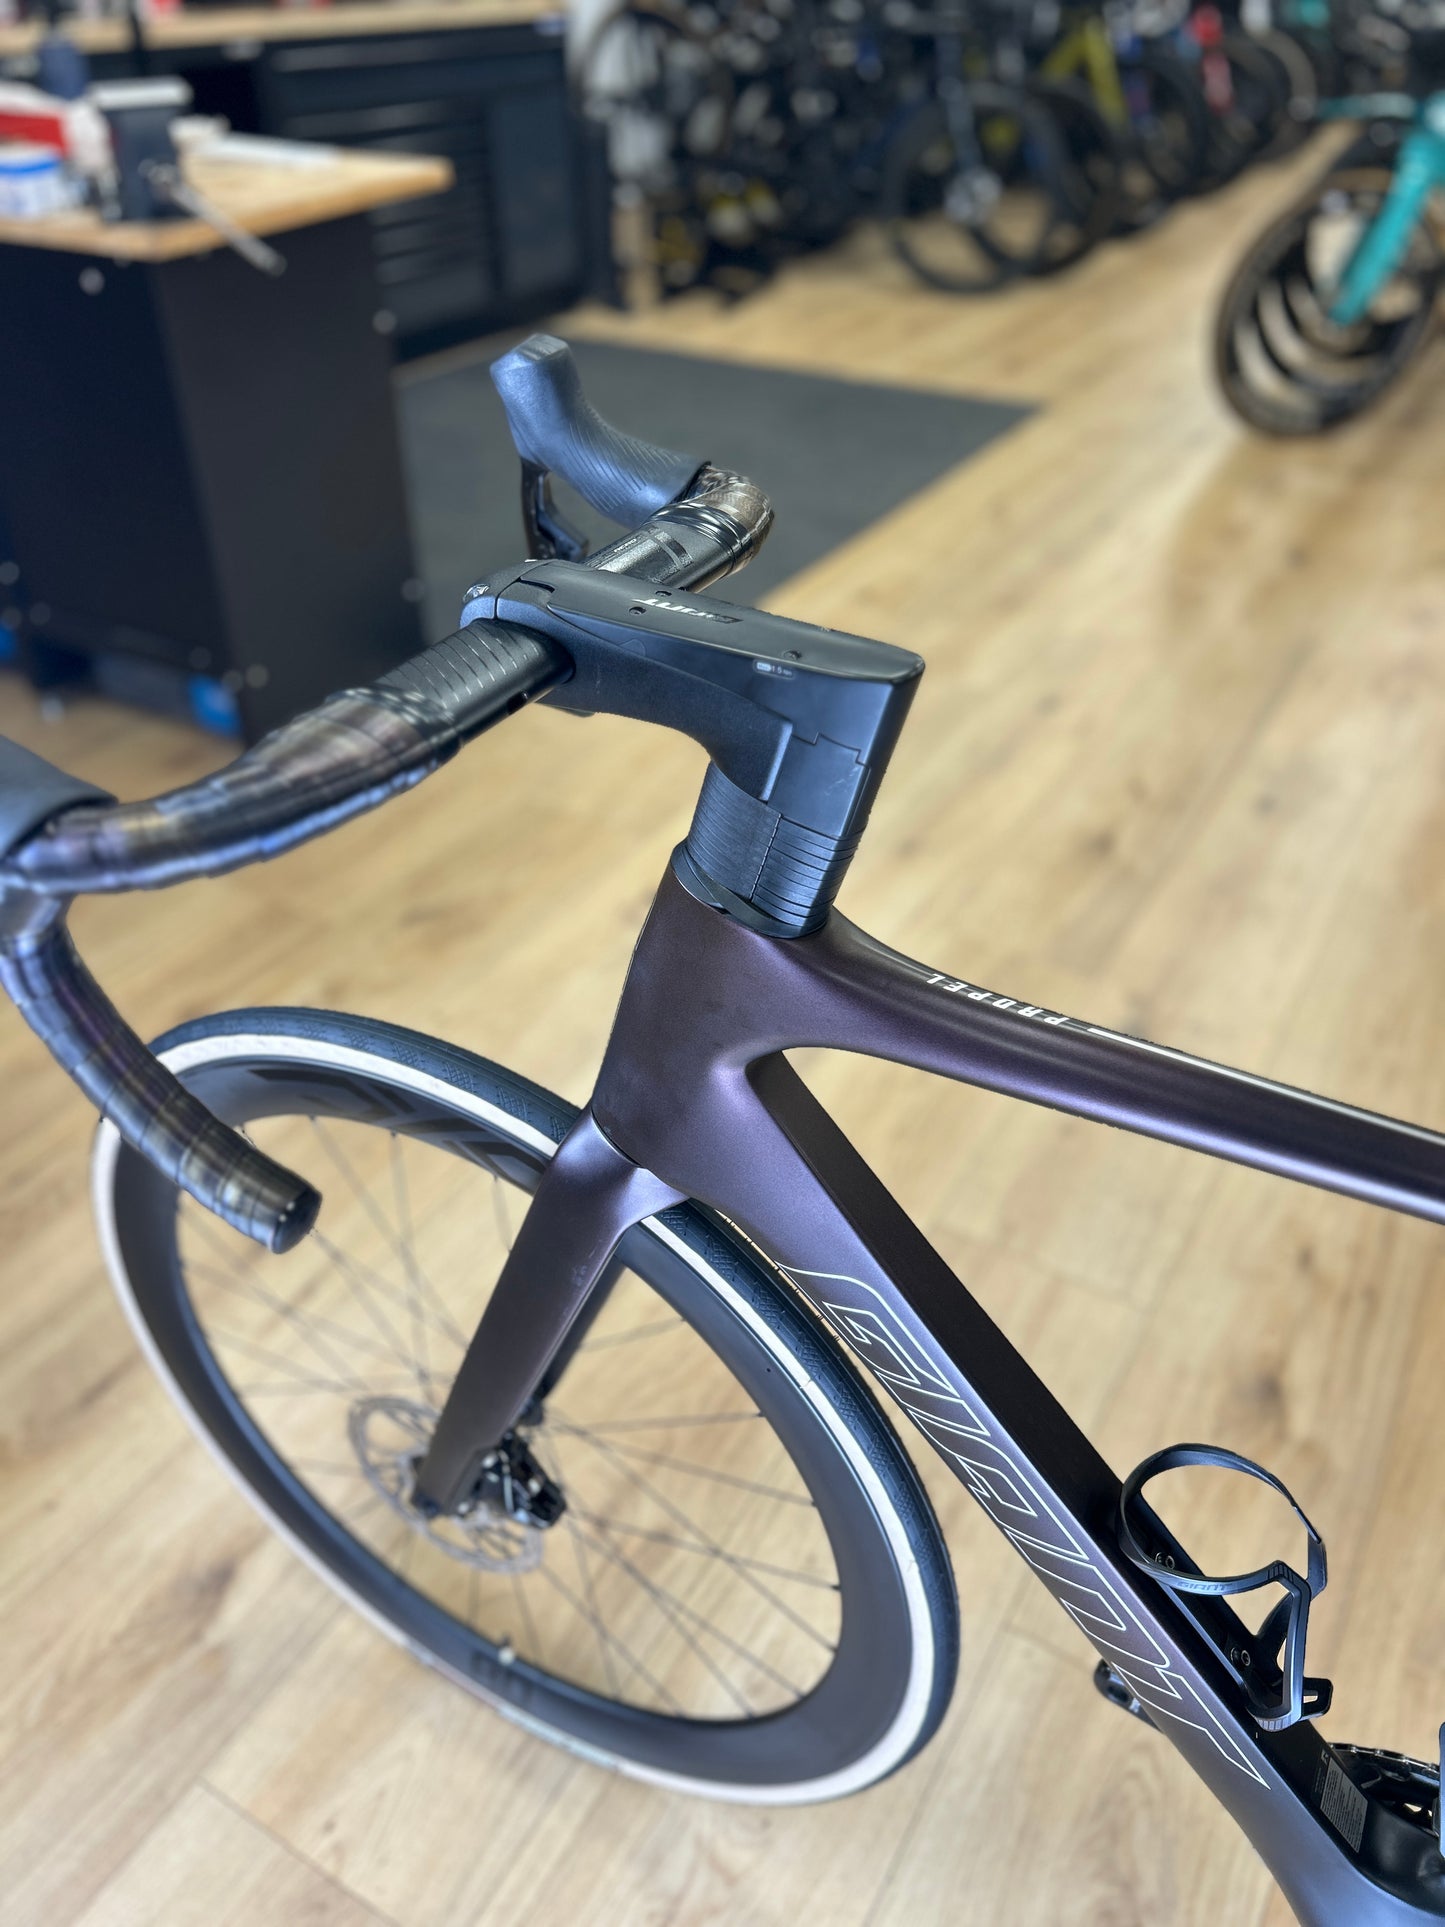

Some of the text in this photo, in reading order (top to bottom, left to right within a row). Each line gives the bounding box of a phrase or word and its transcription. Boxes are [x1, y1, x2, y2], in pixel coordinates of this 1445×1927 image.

[926, 973, 1069, 1026] PROPEL
[775, 1262, 1271, 1790] GIANT
[1177, 1581, 1232, 1592] GIANT
